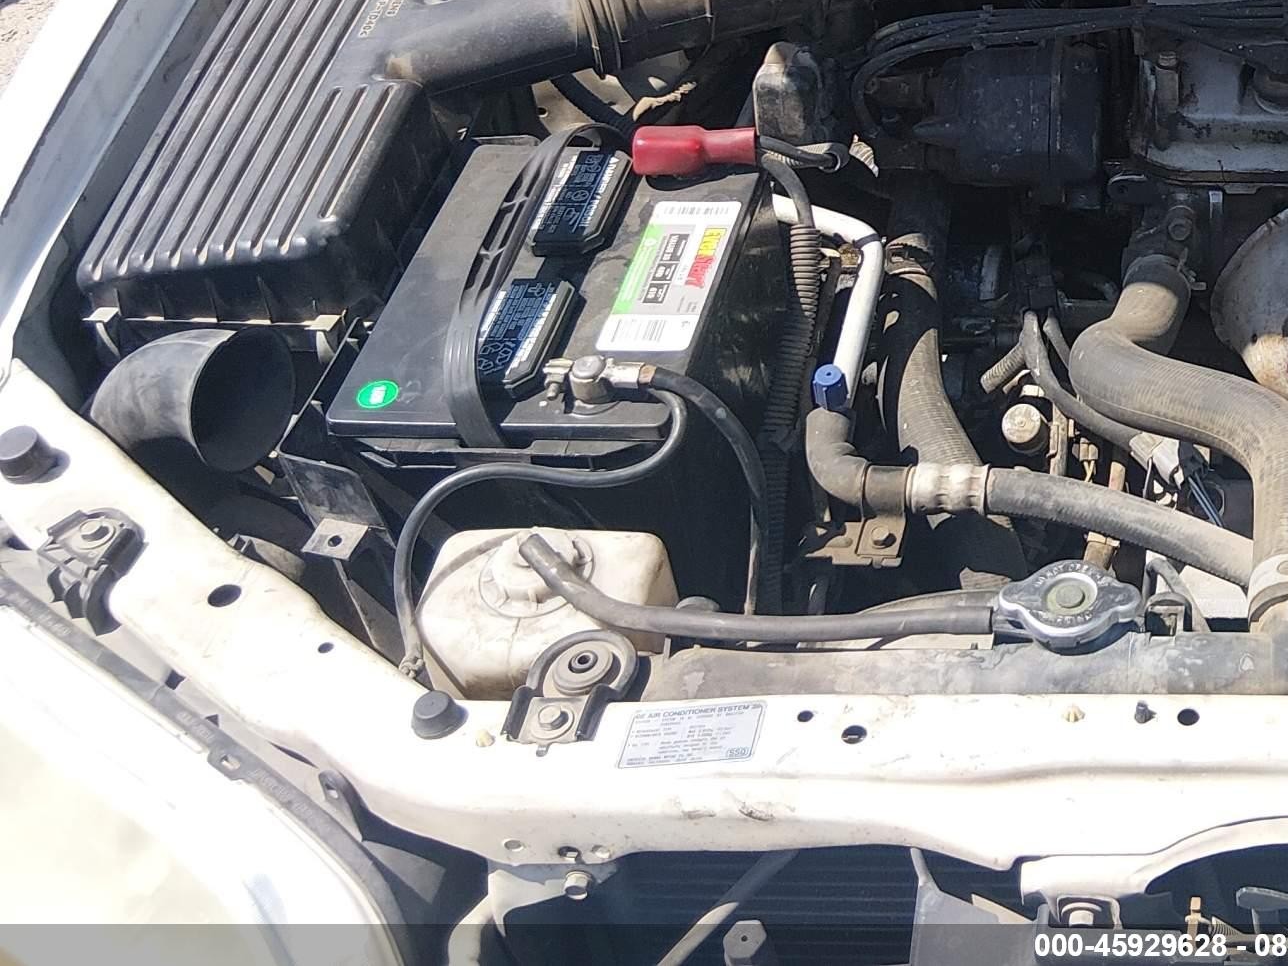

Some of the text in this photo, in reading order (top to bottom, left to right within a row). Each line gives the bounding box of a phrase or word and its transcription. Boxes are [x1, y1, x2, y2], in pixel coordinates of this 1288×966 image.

[647, 712, 661, 720] AIR
[663, 707, 717, 718] CONDITIONER
[717, 704, 750, 712] SYSTEM
